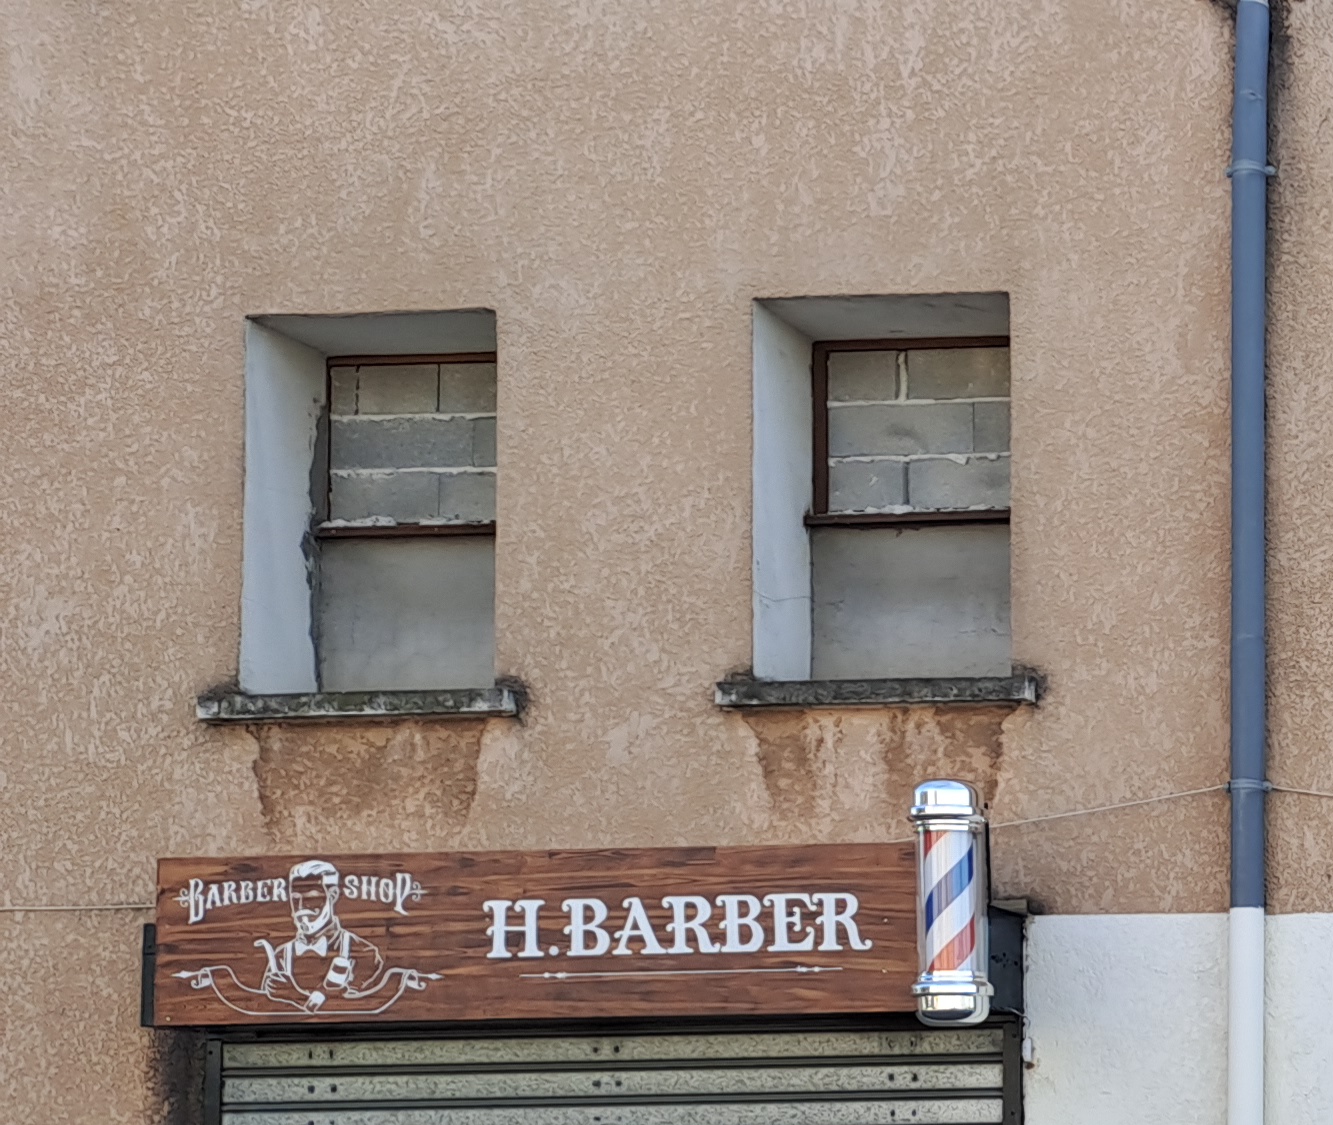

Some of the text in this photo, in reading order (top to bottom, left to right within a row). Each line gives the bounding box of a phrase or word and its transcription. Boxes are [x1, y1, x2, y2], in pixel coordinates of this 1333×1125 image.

[178, 873, 423, 924] BARBER SHOP
[482, 892, 873, 959] H.BARBER
